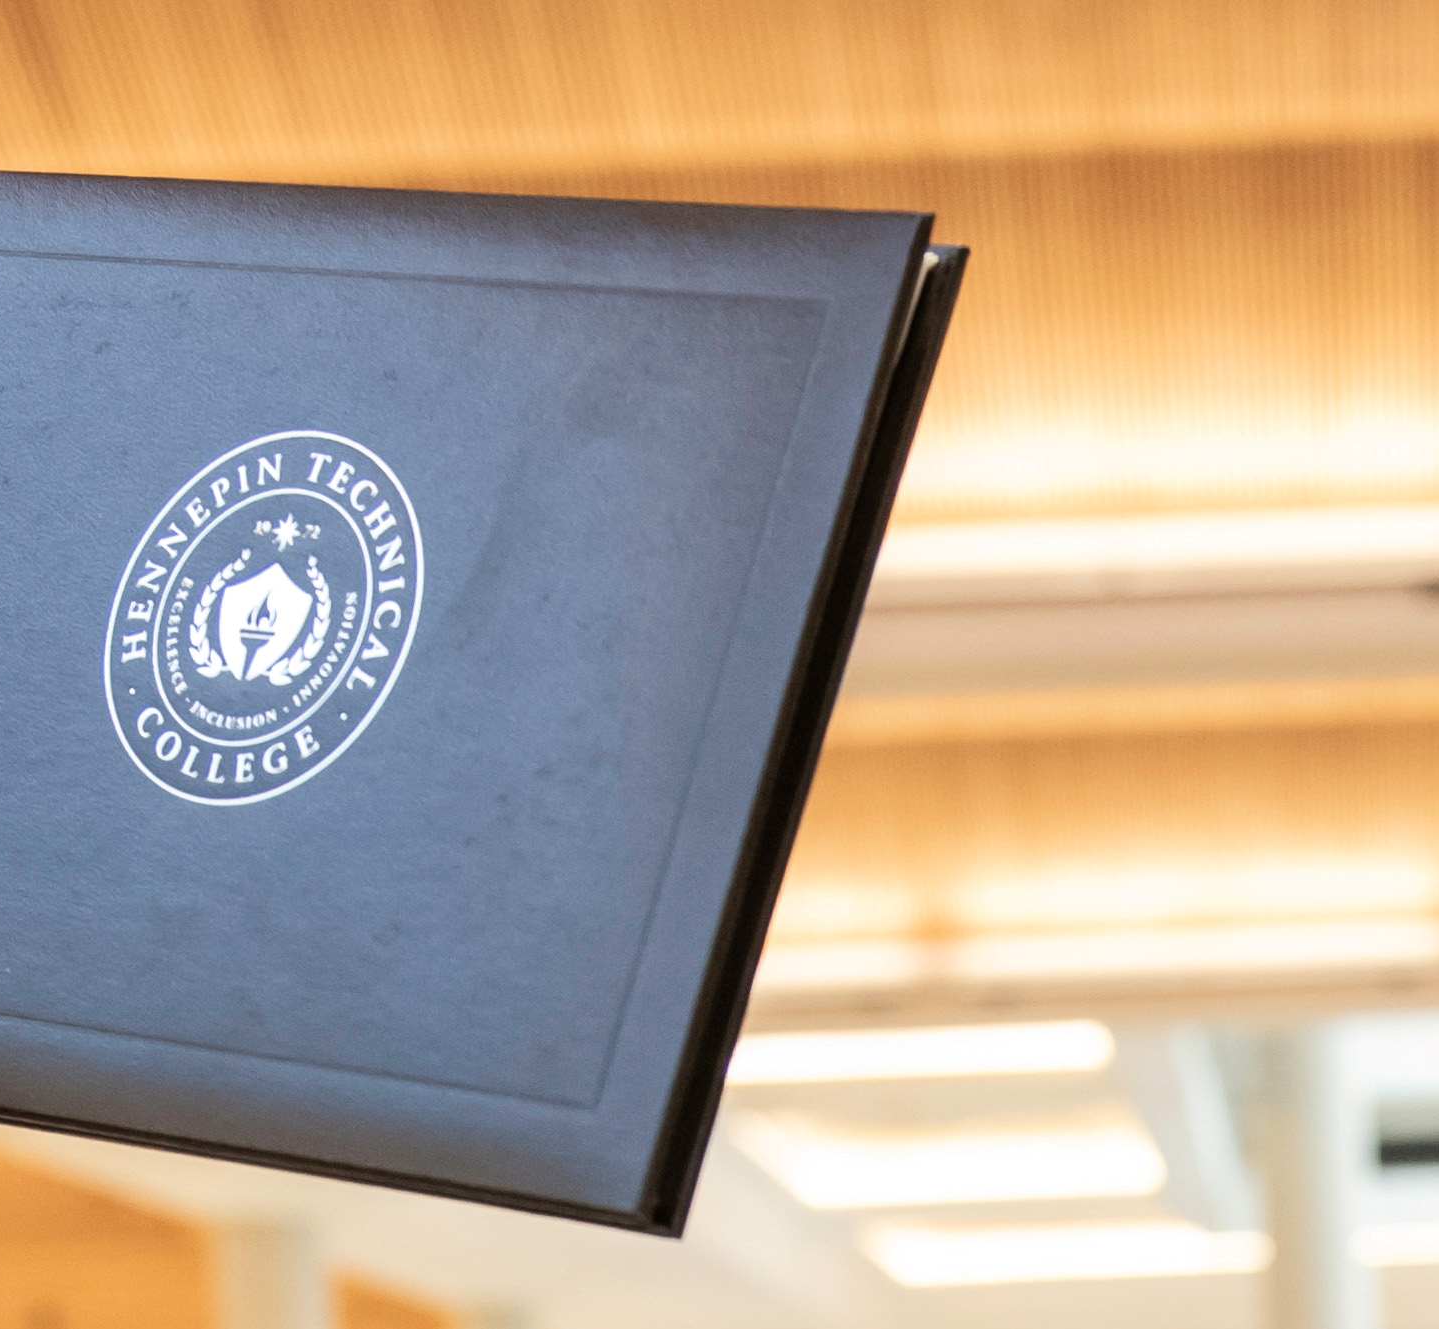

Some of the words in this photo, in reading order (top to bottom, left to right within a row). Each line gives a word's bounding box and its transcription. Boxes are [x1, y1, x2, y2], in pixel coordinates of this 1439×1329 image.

[121, 453, 283, 664] HENNEPIN
[307, 452, 406, 690] TECHNICAL
[165, 576, 195, 695] EXCELLENCE
[189, 700, 278, 730] INCLUSION
[136, 706, 321, 785] COLLEGE
